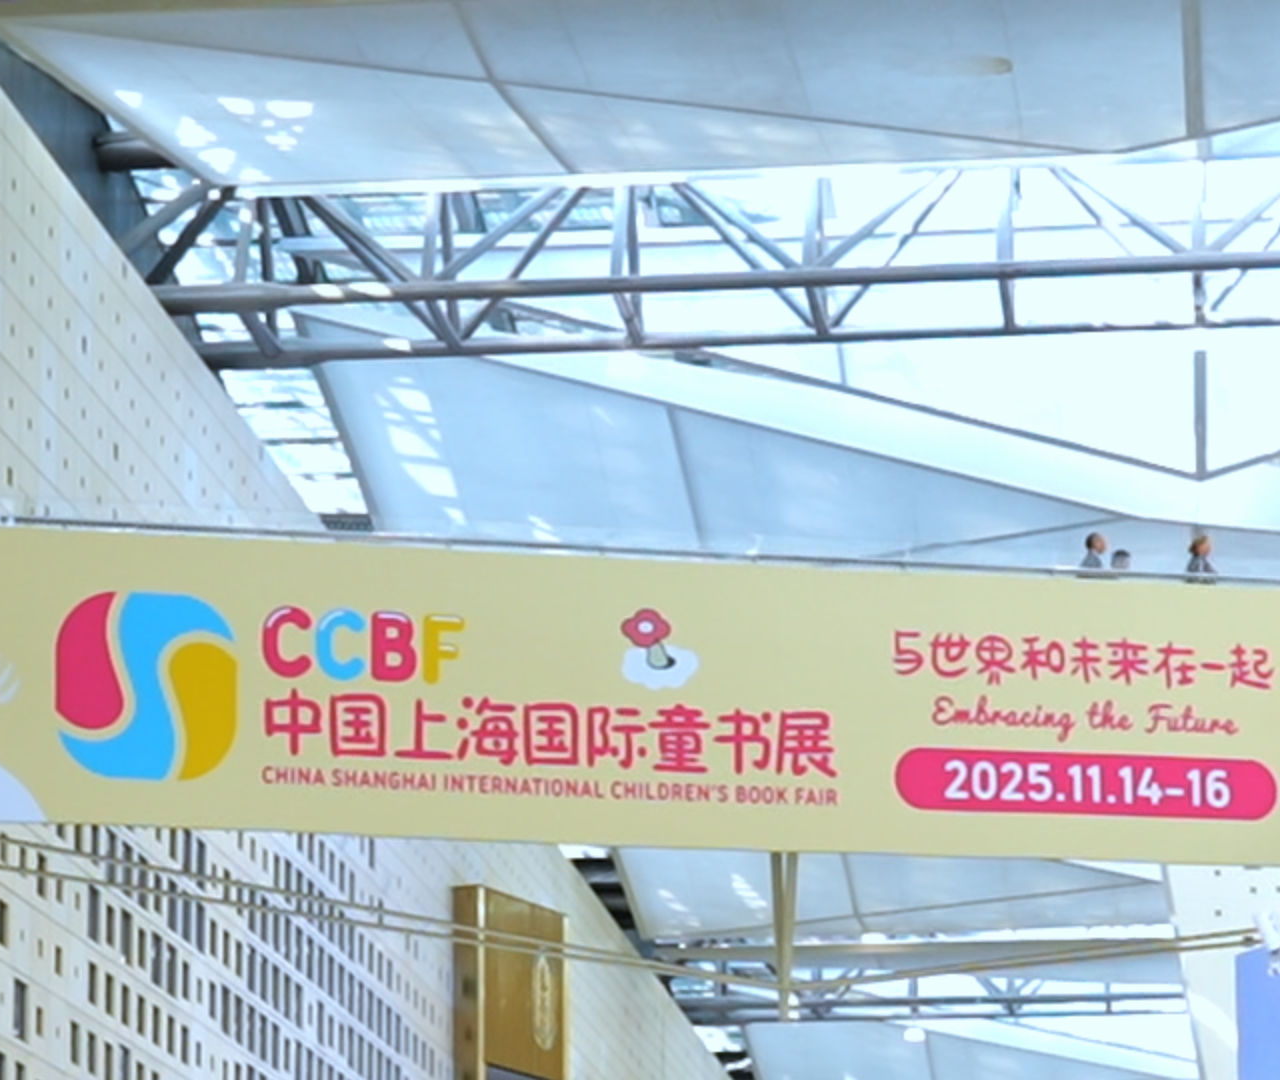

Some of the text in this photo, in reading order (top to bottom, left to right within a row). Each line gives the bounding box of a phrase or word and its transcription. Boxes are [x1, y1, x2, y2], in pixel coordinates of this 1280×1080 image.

[261, 606, 466, 684] CCBF
[263, 689, 838, 779] 中国上海国际童书展
[932, 696, 1239, 742] Embracing the Future
[262, 767, 839, 806] CHINA SHANGHAI INTERNATIONAL CHILDREN'S BOOK FAIR
[943, 759, 1233, 809] 2025.11.14-16
